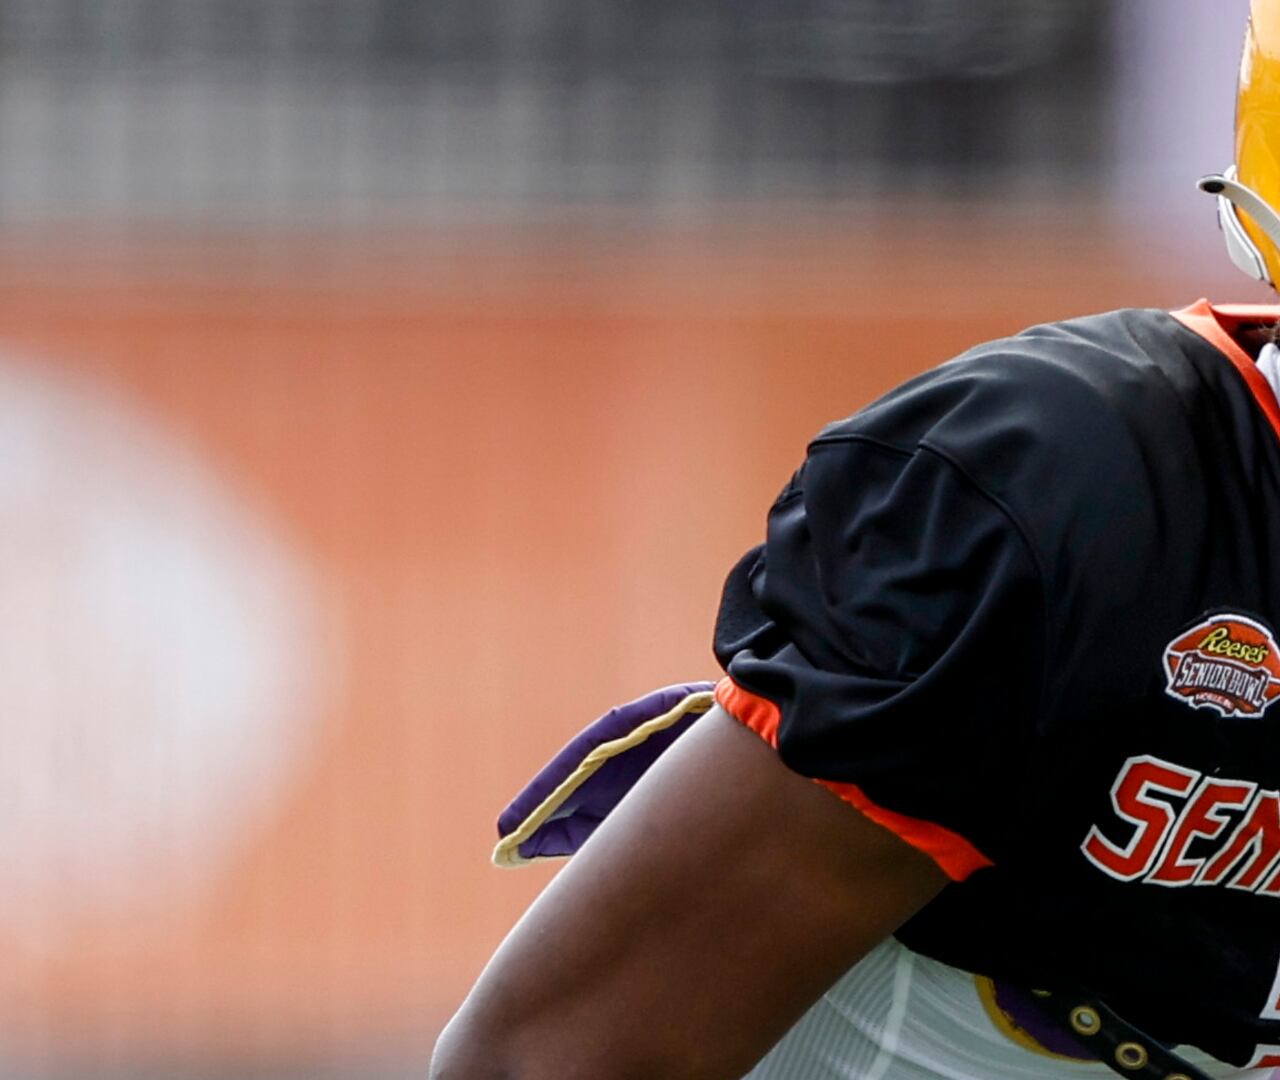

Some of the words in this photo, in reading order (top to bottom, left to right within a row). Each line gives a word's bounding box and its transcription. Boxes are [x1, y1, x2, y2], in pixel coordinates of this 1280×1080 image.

[1198, 627, 1269, 663] Reese's
[1176, 657, 1229, 690] SENIOR
[1228, 669, 1267, 706] BOWL
